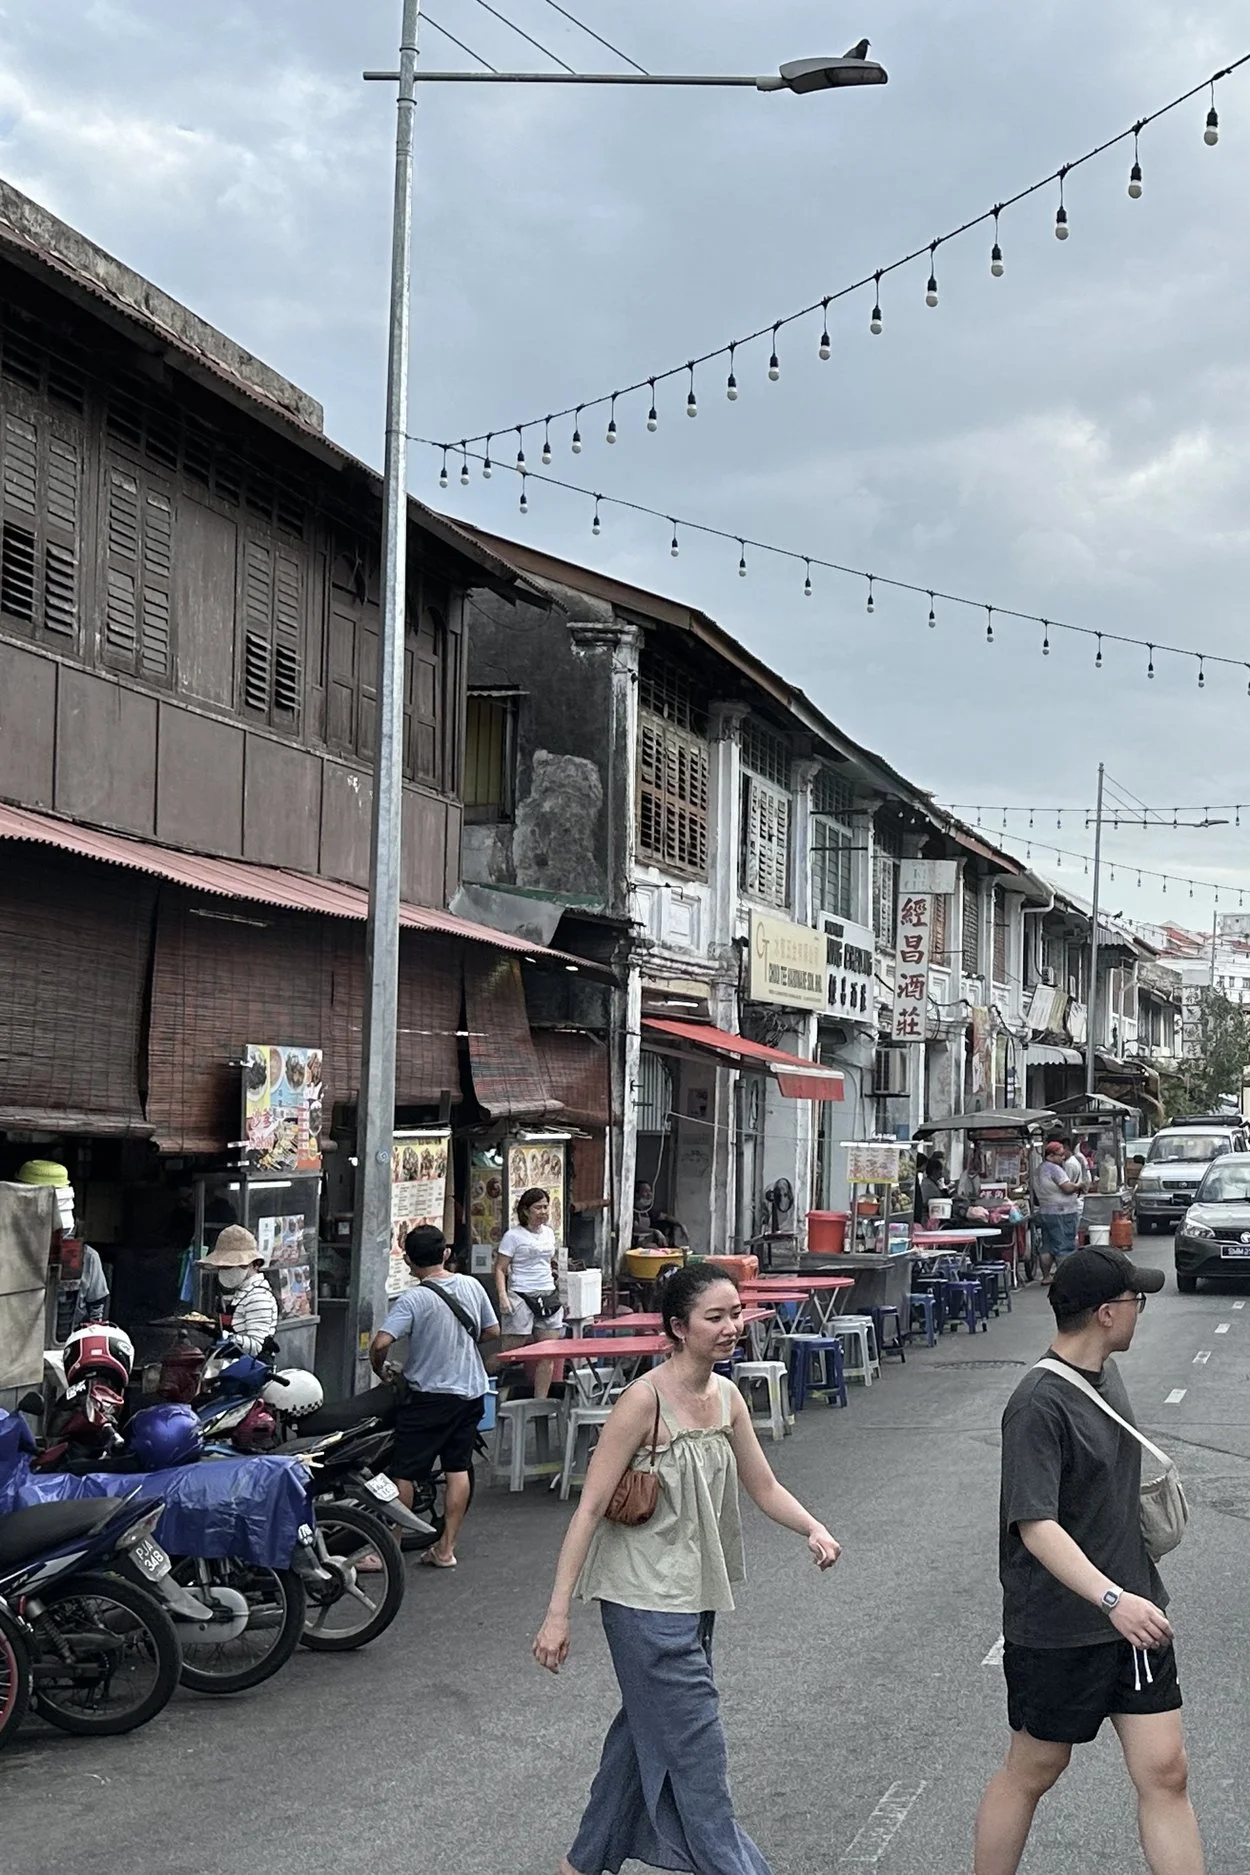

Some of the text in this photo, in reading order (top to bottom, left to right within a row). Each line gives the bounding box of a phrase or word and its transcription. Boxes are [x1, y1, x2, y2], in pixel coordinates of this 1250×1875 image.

[896, 897, 928, 1037] 經昌酒莊
[135, 1540, 153, 1560] PJA
[144, 1550, 164, 1572] 348
